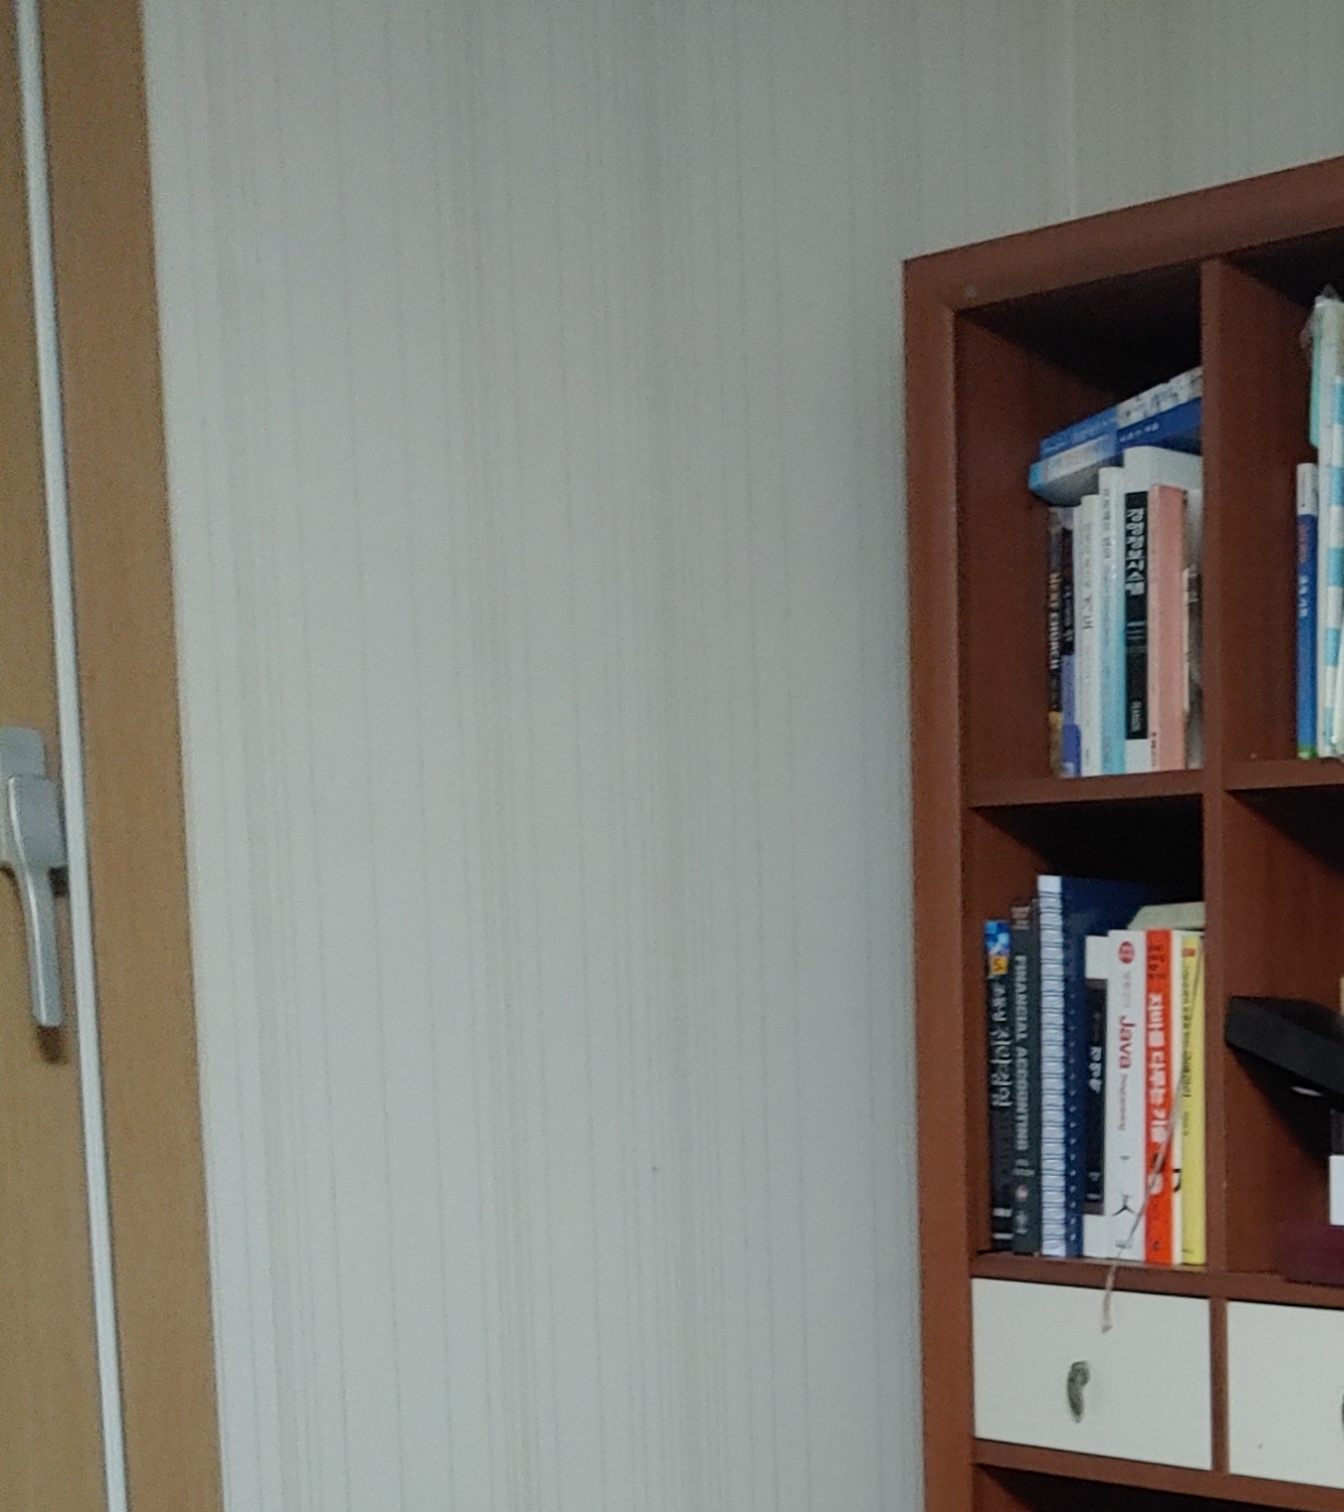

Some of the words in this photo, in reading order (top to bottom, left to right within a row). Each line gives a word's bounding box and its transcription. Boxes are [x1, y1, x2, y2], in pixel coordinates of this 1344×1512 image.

[1013, 954, 1028, 1042] FINANCIAL
[1116, 1015, 1137, 1070] Java
[1014, 1045, 1030, 1151] ACCOUNTING
